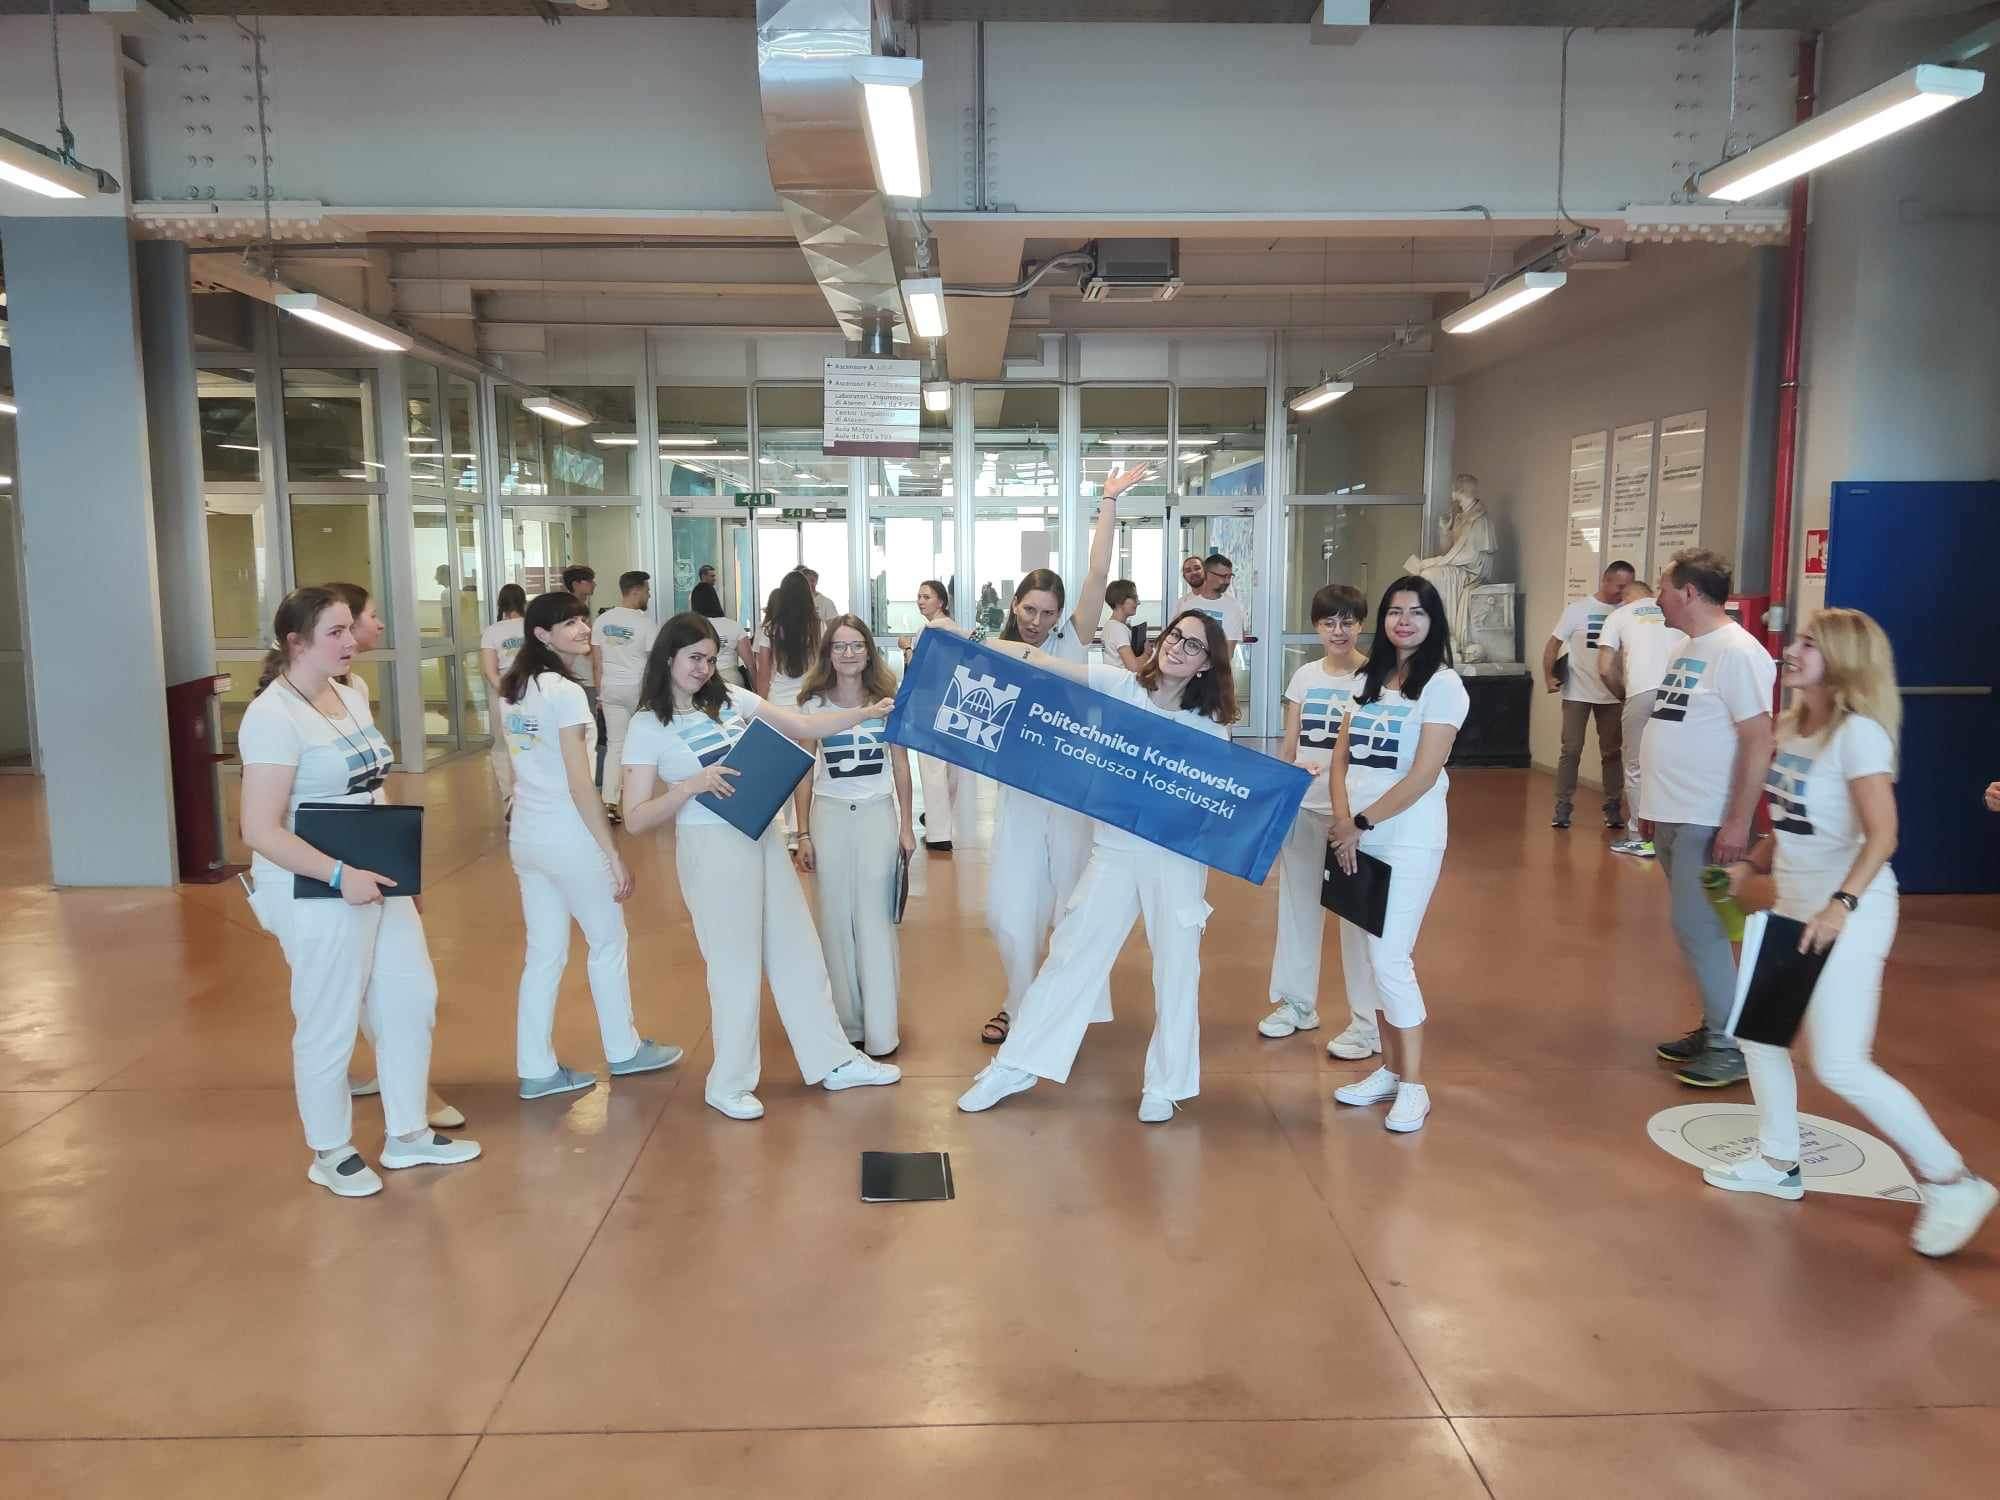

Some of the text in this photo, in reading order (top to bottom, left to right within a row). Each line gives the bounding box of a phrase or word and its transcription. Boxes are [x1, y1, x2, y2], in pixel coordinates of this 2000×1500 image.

[936, 707, 1001, 749] PK
[1019, 724, 1237, 820] im. Tadeusza Kościuszki
[1027, 702, 1251, 800] Politechnika Krakowska
